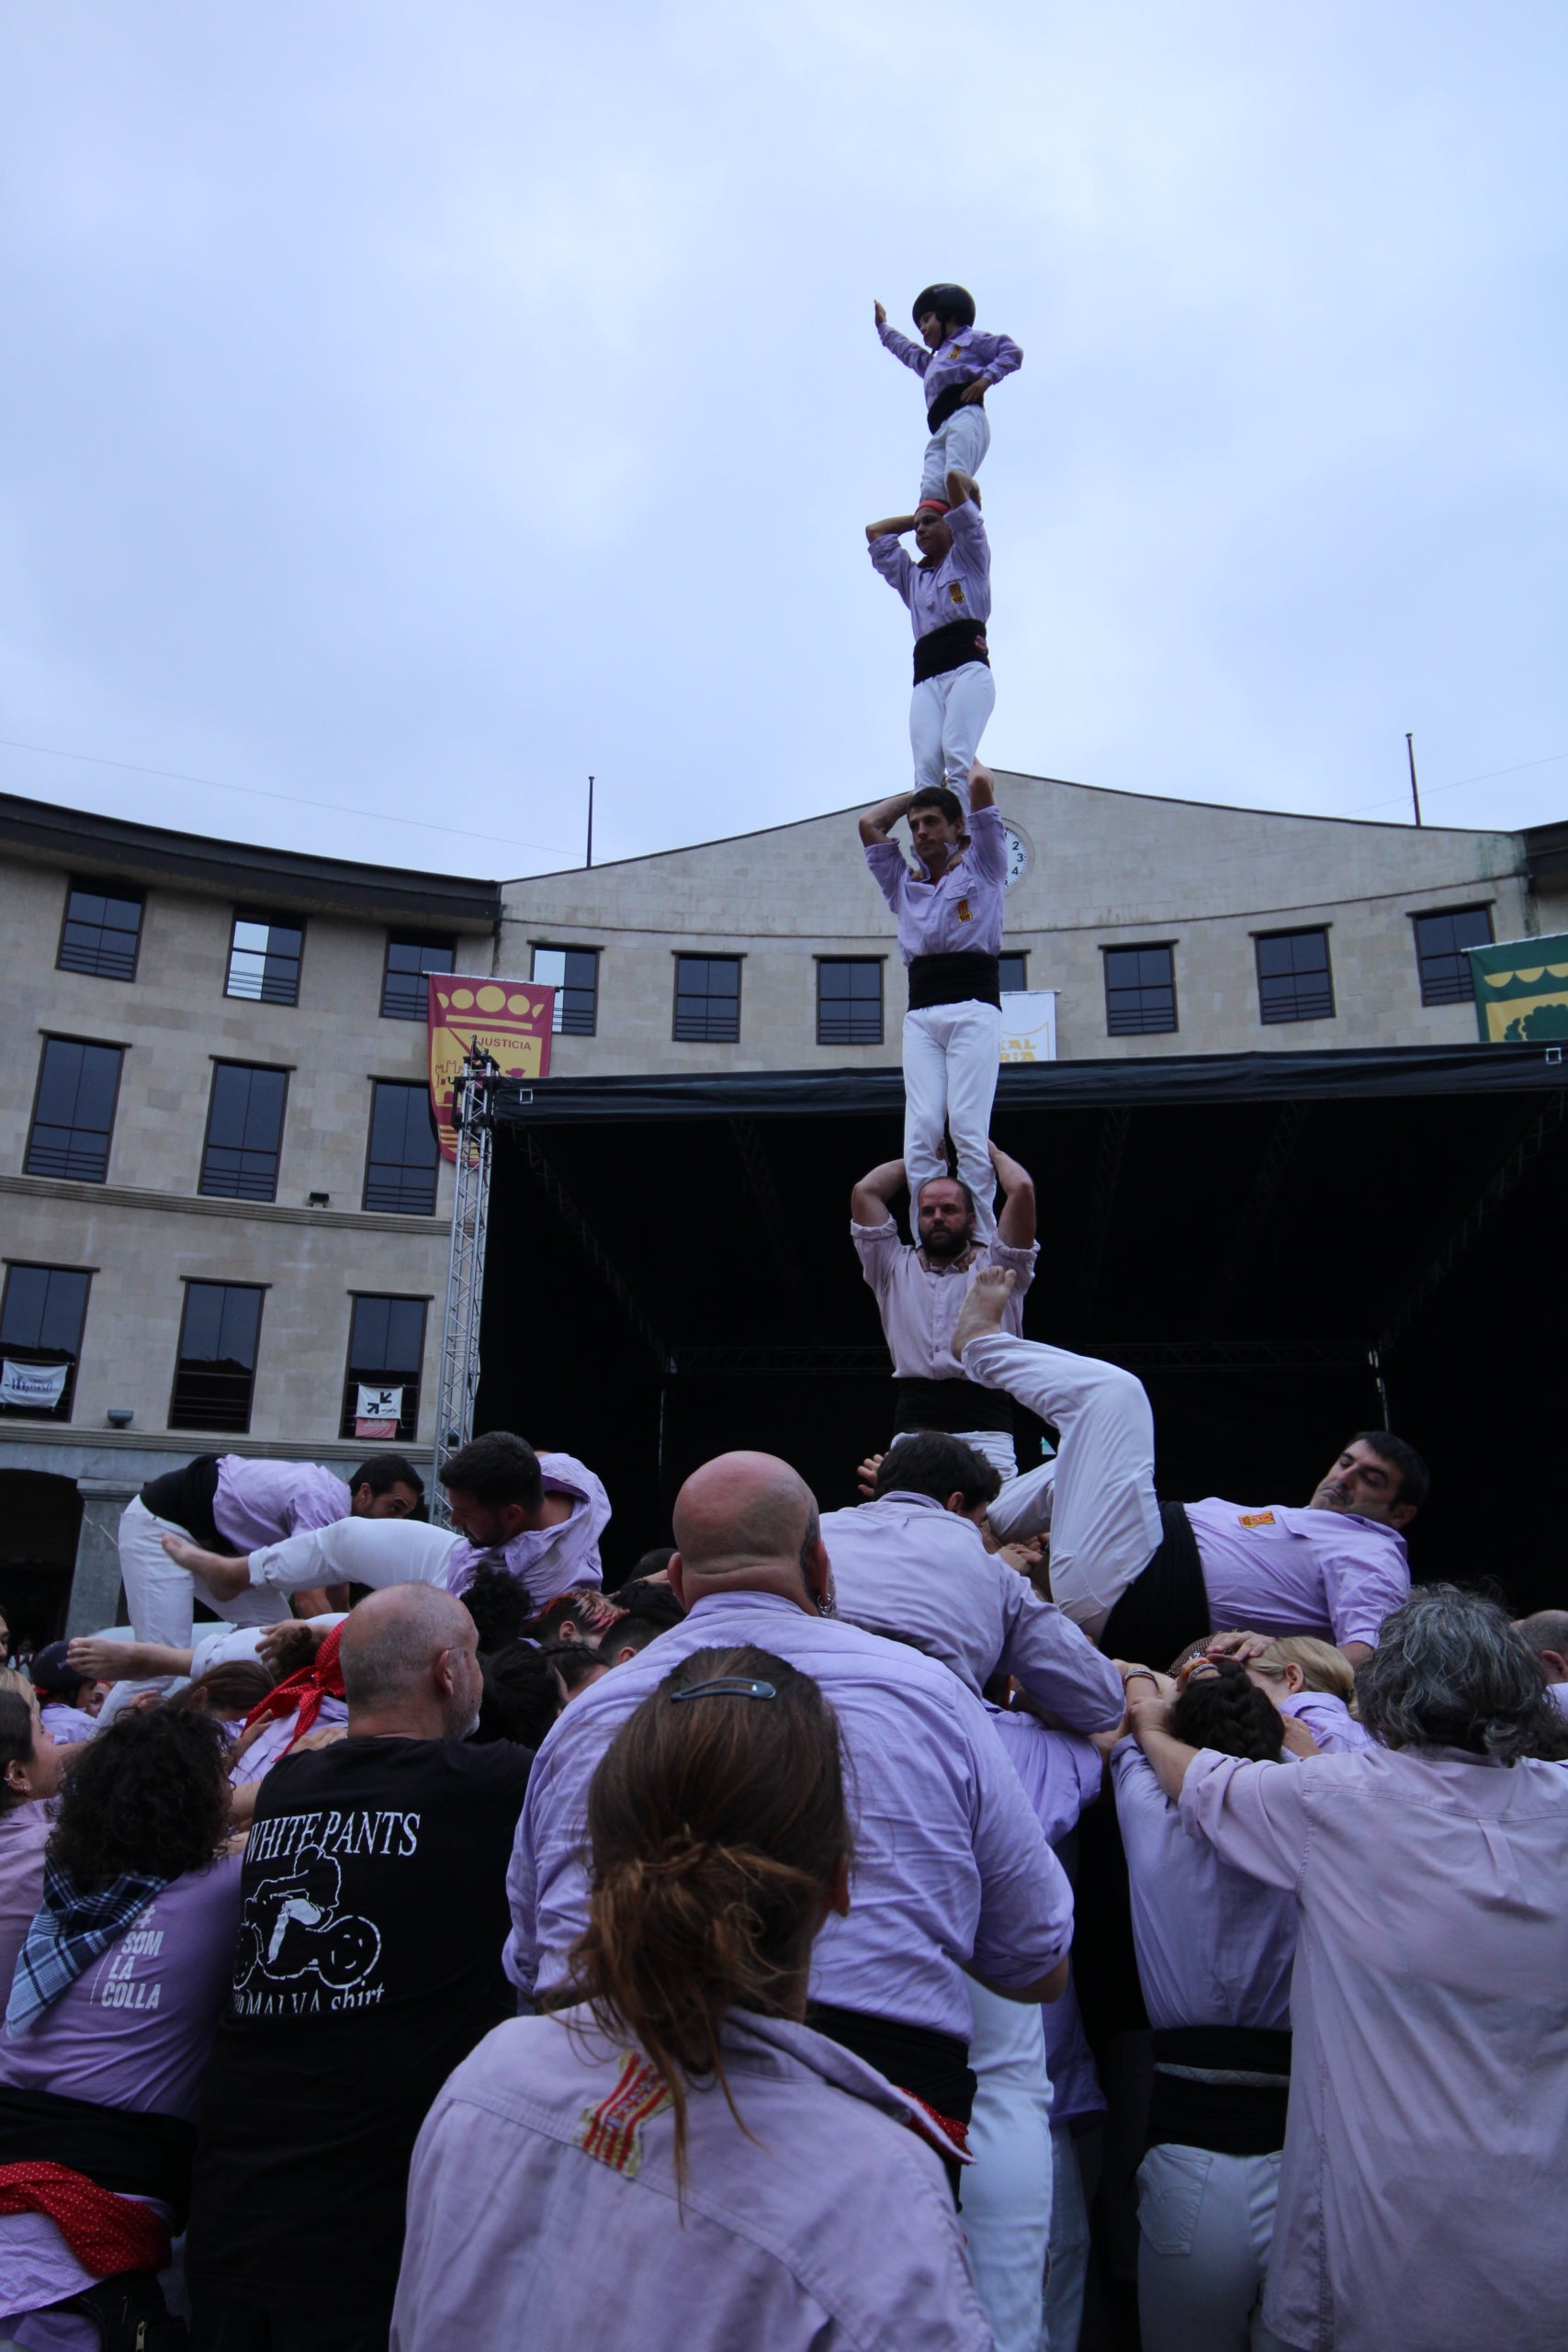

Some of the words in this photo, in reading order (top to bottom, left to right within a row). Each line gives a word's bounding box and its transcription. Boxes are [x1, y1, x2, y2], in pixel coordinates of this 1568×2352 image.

[1012, 841, 1020, 851] 2
[1017, 853, 1024, 863] 3
[1011, 866, 1019, 875] 4
[478, 1036, 532, 1051] JUSTICIA
[245, 1811, 323, 1865] WHITE
[321, 1811, 422, 1856] PANTS
[121, 1930, 164, 1956] SOM
[108, 1955, 135, 1980] LA
[101, 1982, 161, 2009] COLLA
[331, 1982, 385, 2010] shirt
